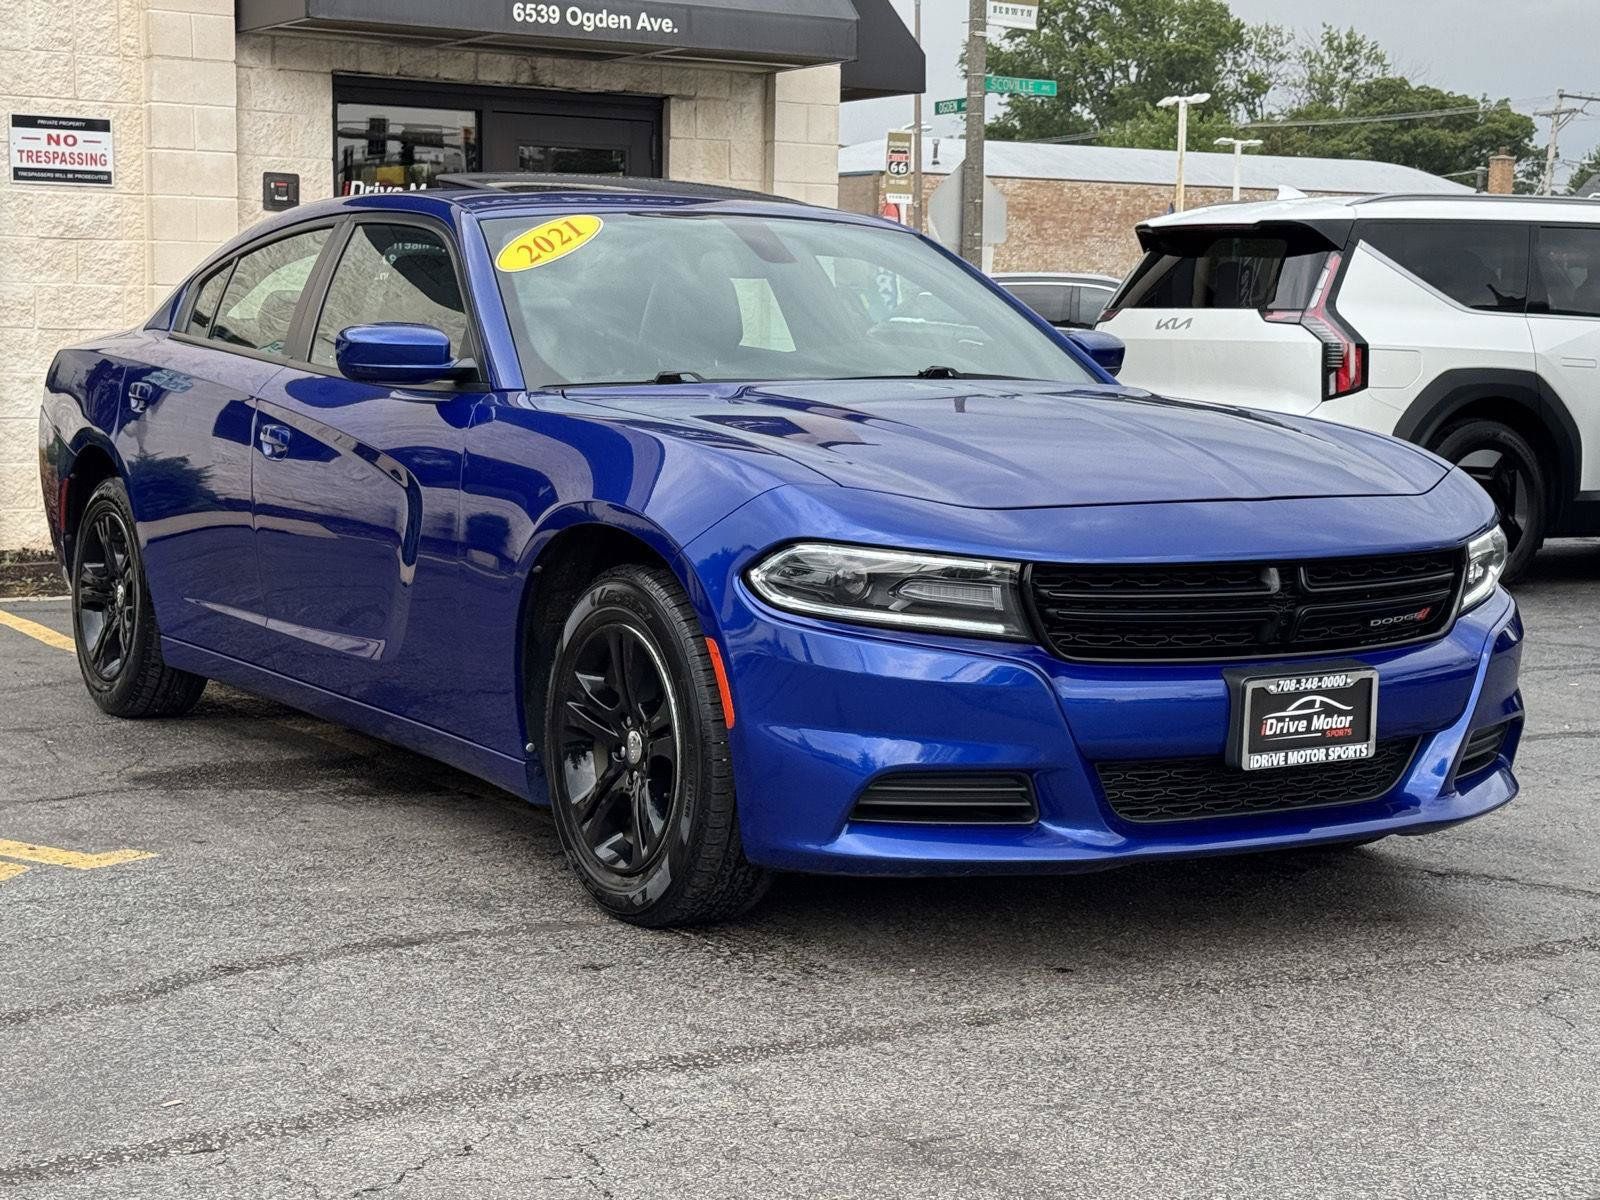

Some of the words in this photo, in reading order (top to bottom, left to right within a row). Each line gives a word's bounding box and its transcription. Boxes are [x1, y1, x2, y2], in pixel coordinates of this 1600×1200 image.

[512, 2, 560, 25] 6539
[565, 6, 632, 32] Ogden
[635, 11, 679, 34] Ave.
[992, 5, 1033, 17] BERWYN
[991, 79, 1035, 92] SCOVILLE
[46, 133, 78, 147] NO
[17, 149, 107, 167] TRESPASSING
[890, 162, 907, 173] 66
[516, 220, 585, 264] 2021
[1155, 317, 1193, 330] KIA
[1370, 612, 1421, 626] DODGE
[1278, 675, 1346, 692] 708-348-0000
[1260, 717, 1308, 736] iDrive
[1311, 714, 1353, 731] Motor
[1326, 728, 1352, 737] SPORTS
[1287, 748, 1326, 765] MOTOR
[1328, 744, 1367, 760] SPORTS
